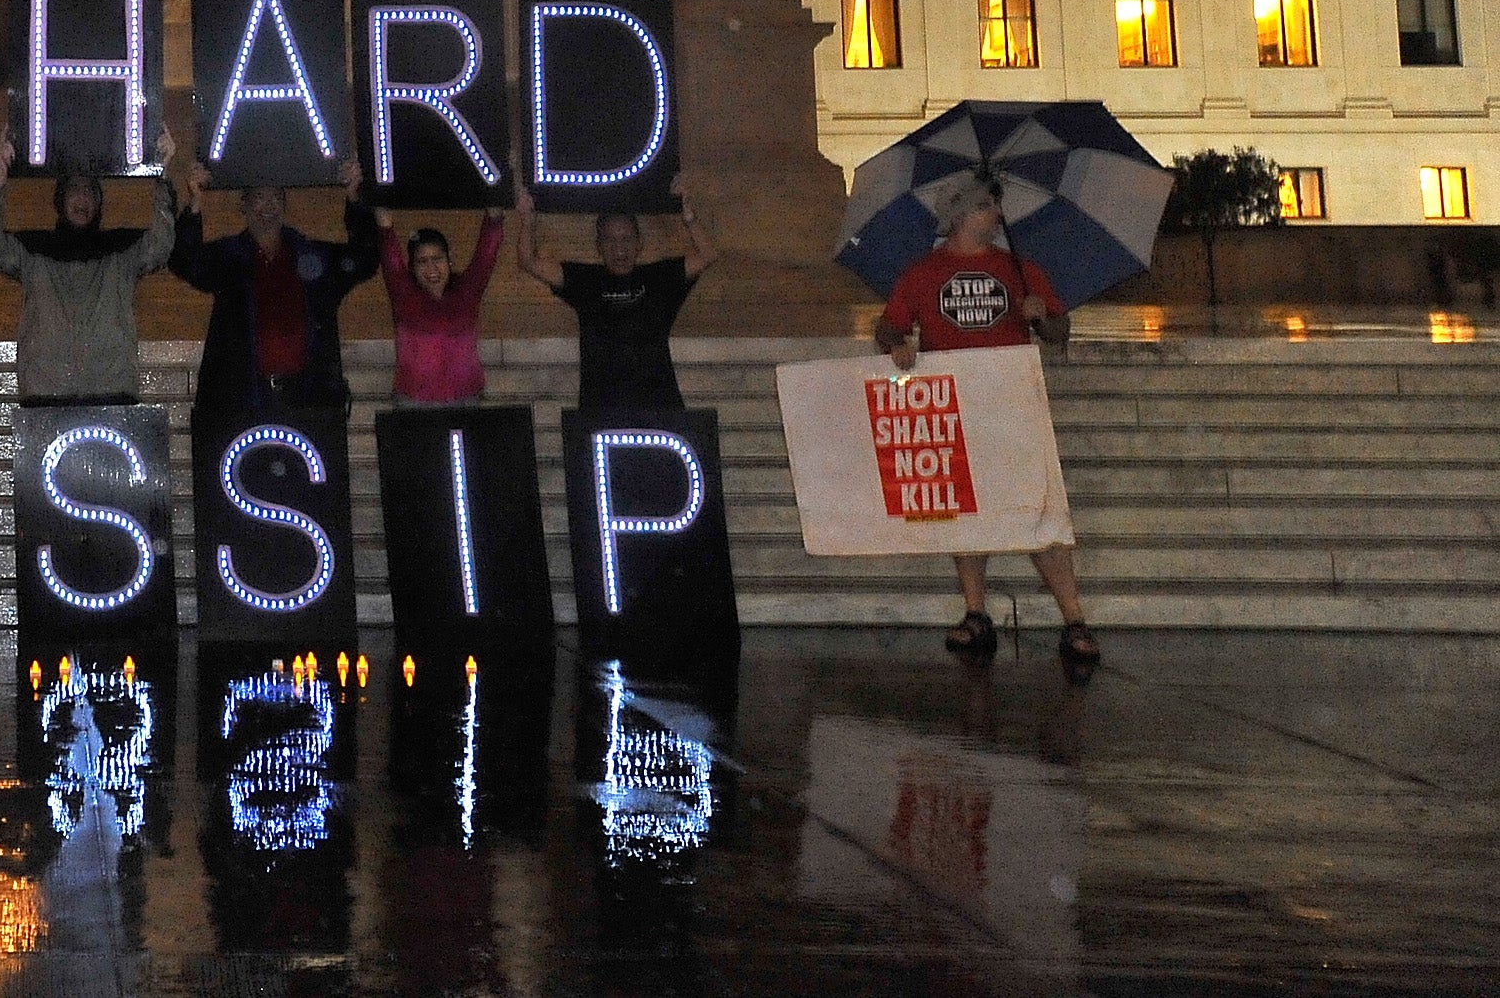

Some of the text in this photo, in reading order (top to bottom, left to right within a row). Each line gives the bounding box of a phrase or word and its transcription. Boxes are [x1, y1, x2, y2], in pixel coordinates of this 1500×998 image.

[944, 296, 1004, 307] EXECUTIONS
[951, 279, 995, 296] STOP
[957, 308, 993, 322] NOW!
[874, 379, 950, 410] THOU
[876, 413, 958, 445] SHALT
[895, 448, 953, 477] NOT
[901, 481, 960, 511] KILL
